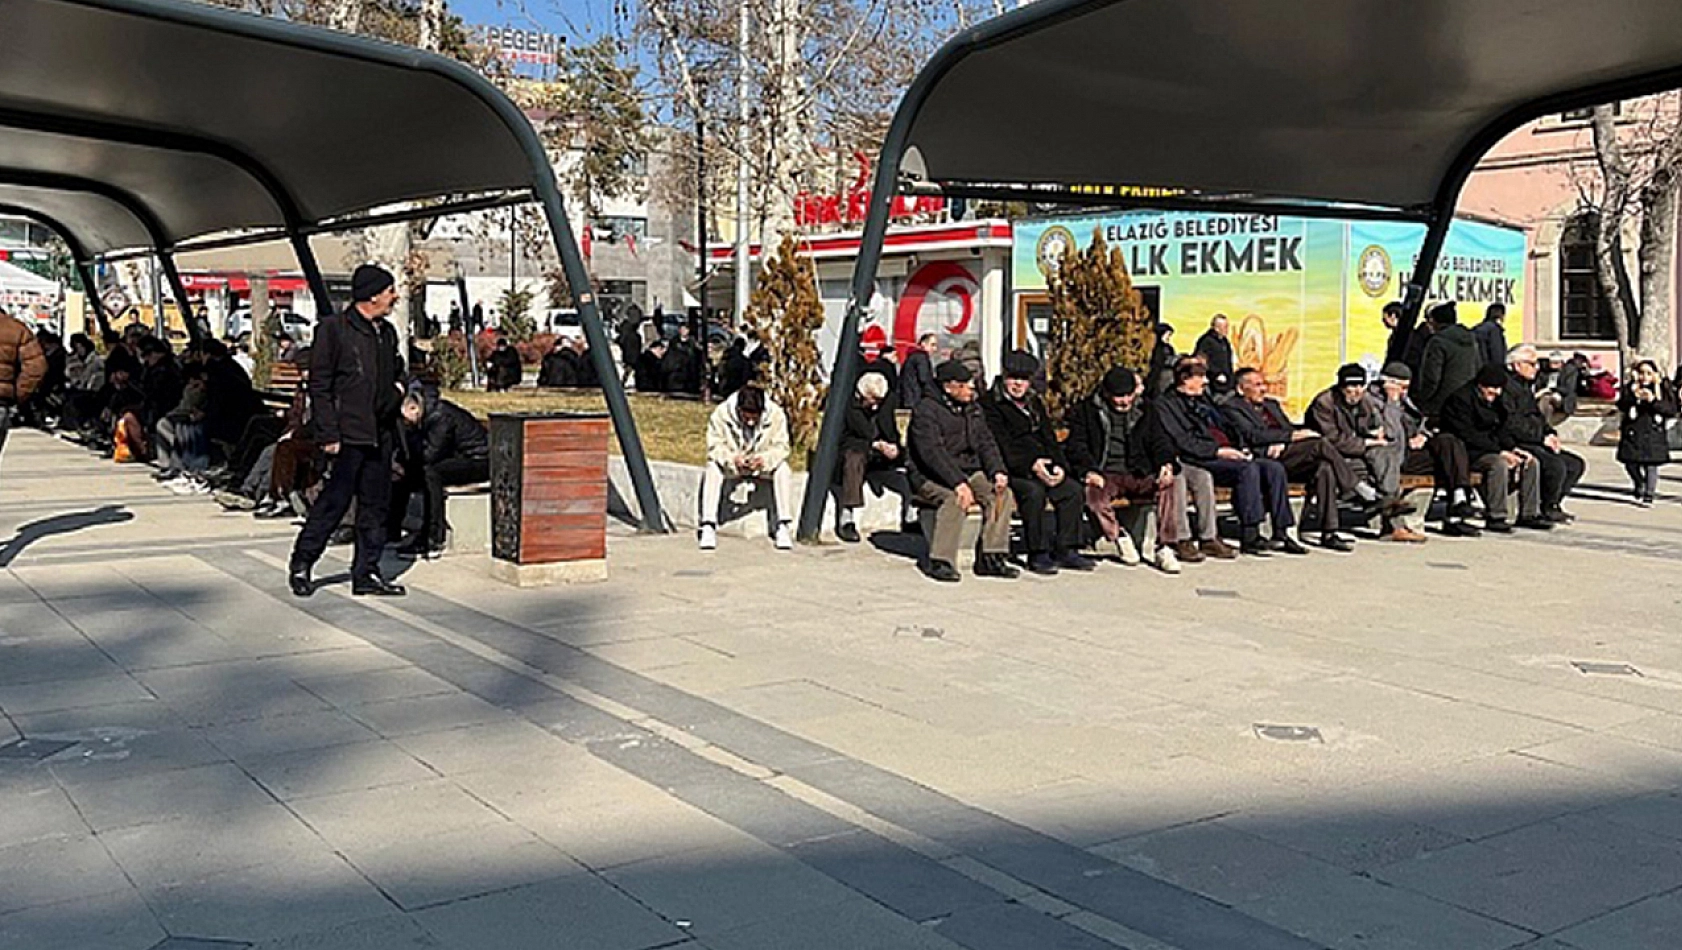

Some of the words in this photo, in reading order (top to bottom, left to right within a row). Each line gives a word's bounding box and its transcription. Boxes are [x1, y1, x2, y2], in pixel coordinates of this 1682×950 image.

[1180, 236, 1303, 274] EKMEK
[1397, 271, 1450, 299] HLK
[1456, 275, 1516, 304] EKMEK
